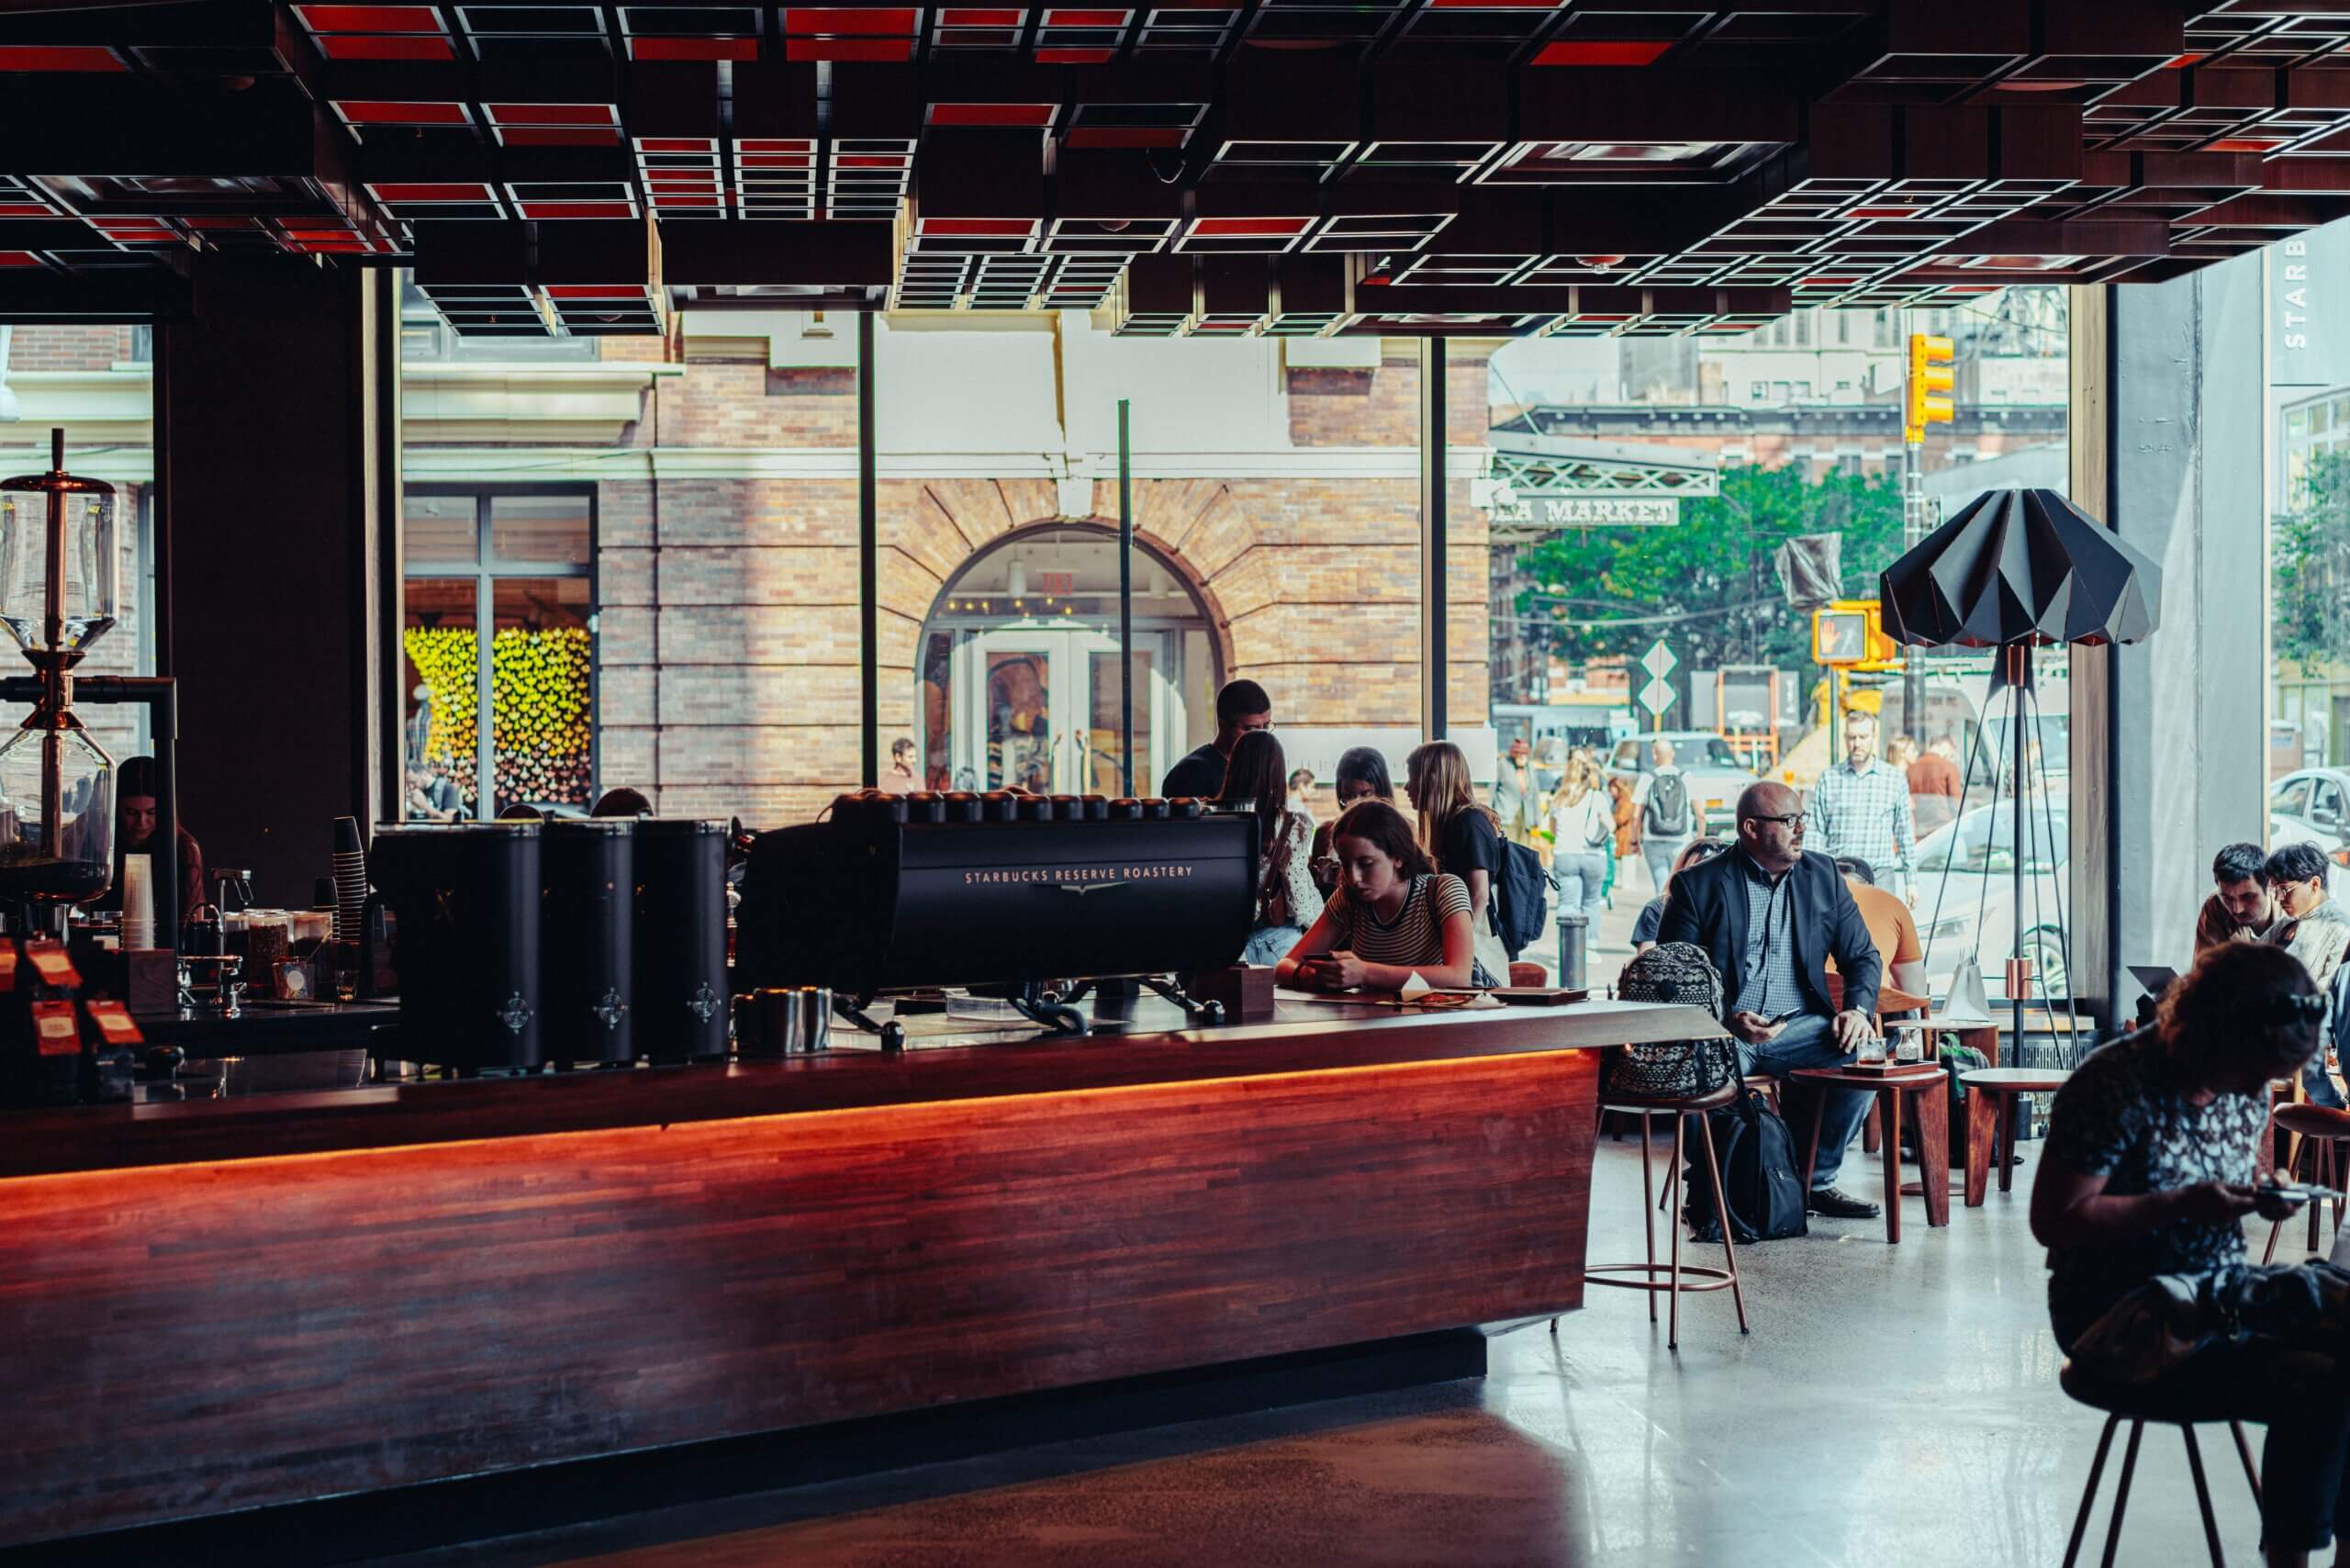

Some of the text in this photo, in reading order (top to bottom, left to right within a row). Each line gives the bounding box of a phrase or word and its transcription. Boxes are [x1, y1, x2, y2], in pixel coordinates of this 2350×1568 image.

[2285, 241, 2307, 350] STARB
[1544, 499, 1673, 521] MARKET
[965, 866, 1192, 883] STARBUCKS RESERVE ROASTERY
